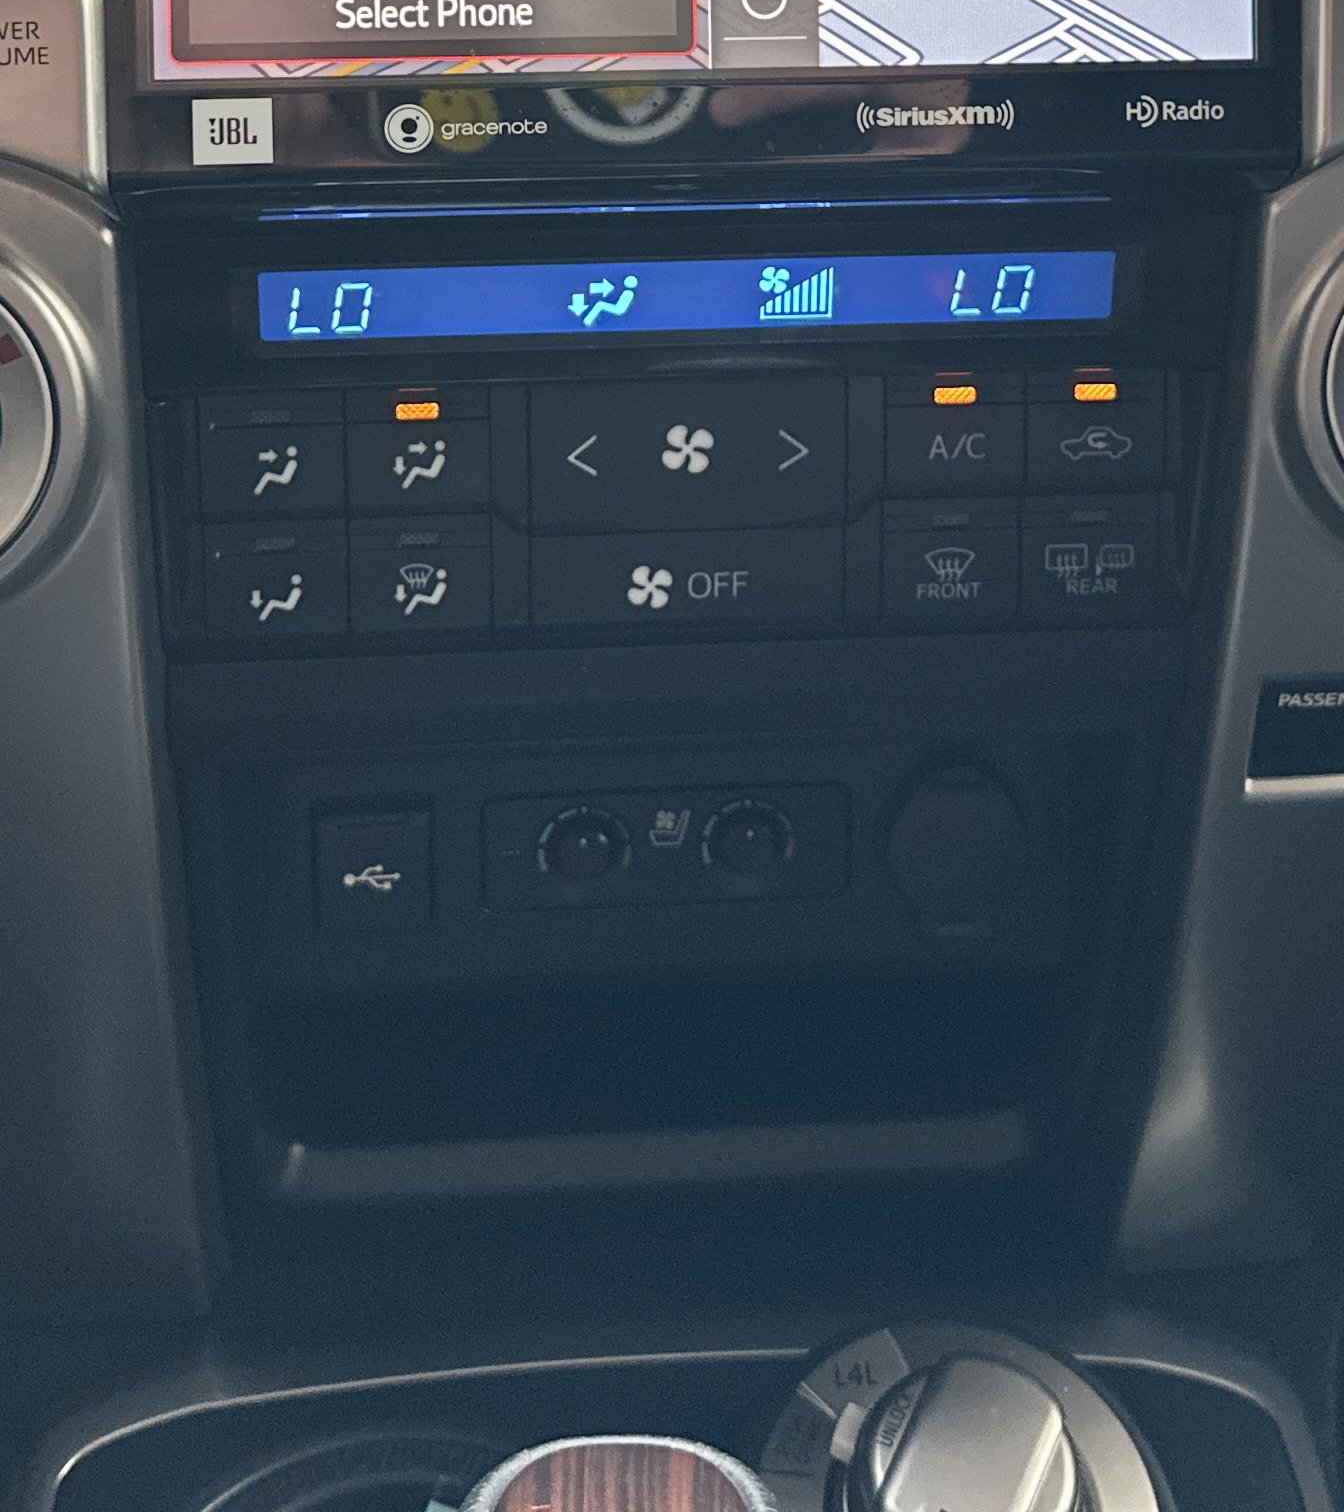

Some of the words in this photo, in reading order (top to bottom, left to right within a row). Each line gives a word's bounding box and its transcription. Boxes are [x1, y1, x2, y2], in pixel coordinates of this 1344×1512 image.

[1162, 98, 1225, 121] Radio
[209, 117, 258, 146] JBL
[440, 118, 549, 141] gracenote
[949, 264, 1036, 317] LO
[287, 281, 374, 335] LO
[928, 433, 988, 462] A/C
[687, 571, 749, 600] OFF
[915, 581, 982, 600] FRONT
[1066, 577, 1118, 595] REAR
